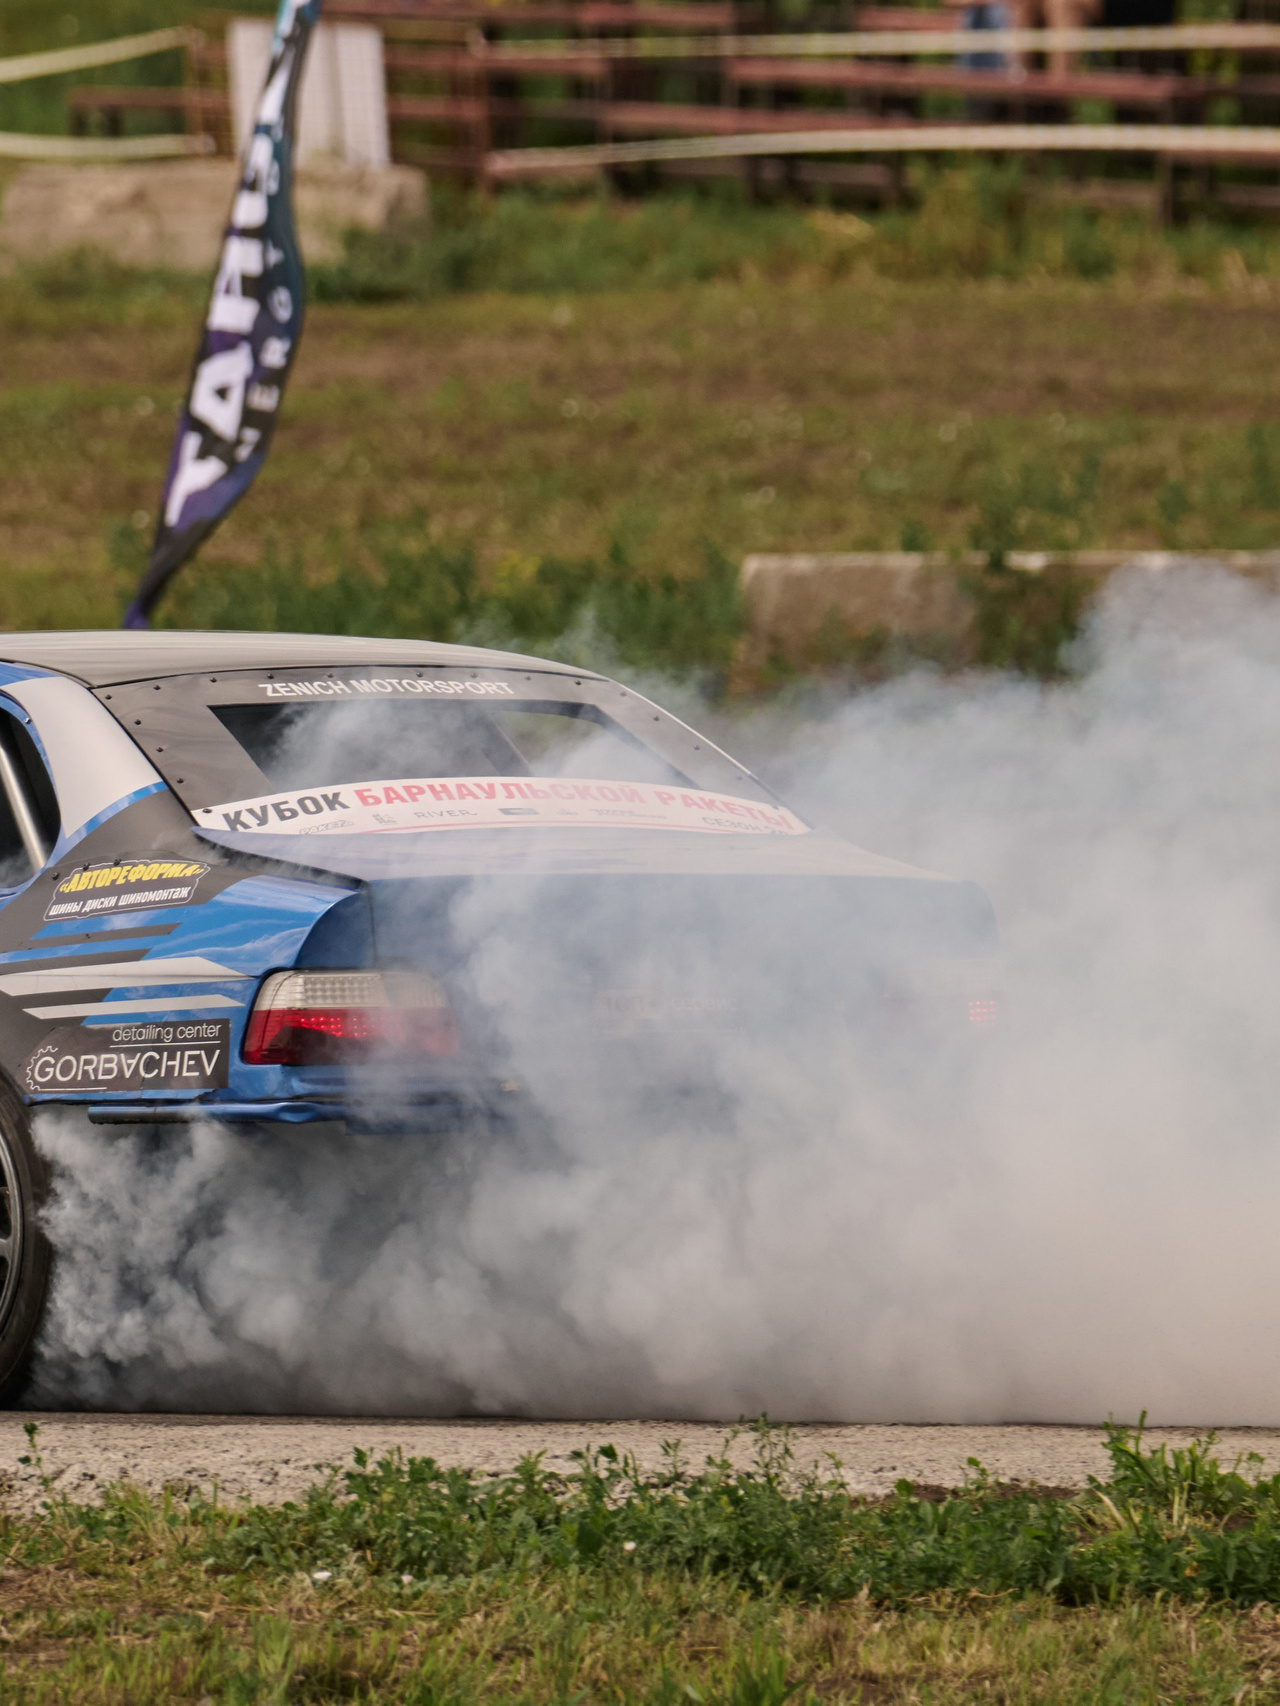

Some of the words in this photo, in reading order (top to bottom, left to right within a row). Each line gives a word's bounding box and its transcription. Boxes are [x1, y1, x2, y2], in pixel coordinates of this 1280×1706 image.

[258, 681, 352, 697] ZENICH
[349, 679, 516, 695] MOTORSPORT
[222, 791, 351, 831] КУБОК
[354, 783, 647, 807] БАРНАУЛЬСКОЙ
[653, 790, 794, 830] РАКЕТЫ
[112, 1024, 174, 1043] detailing
[176, 1024, 222, 1040] center
